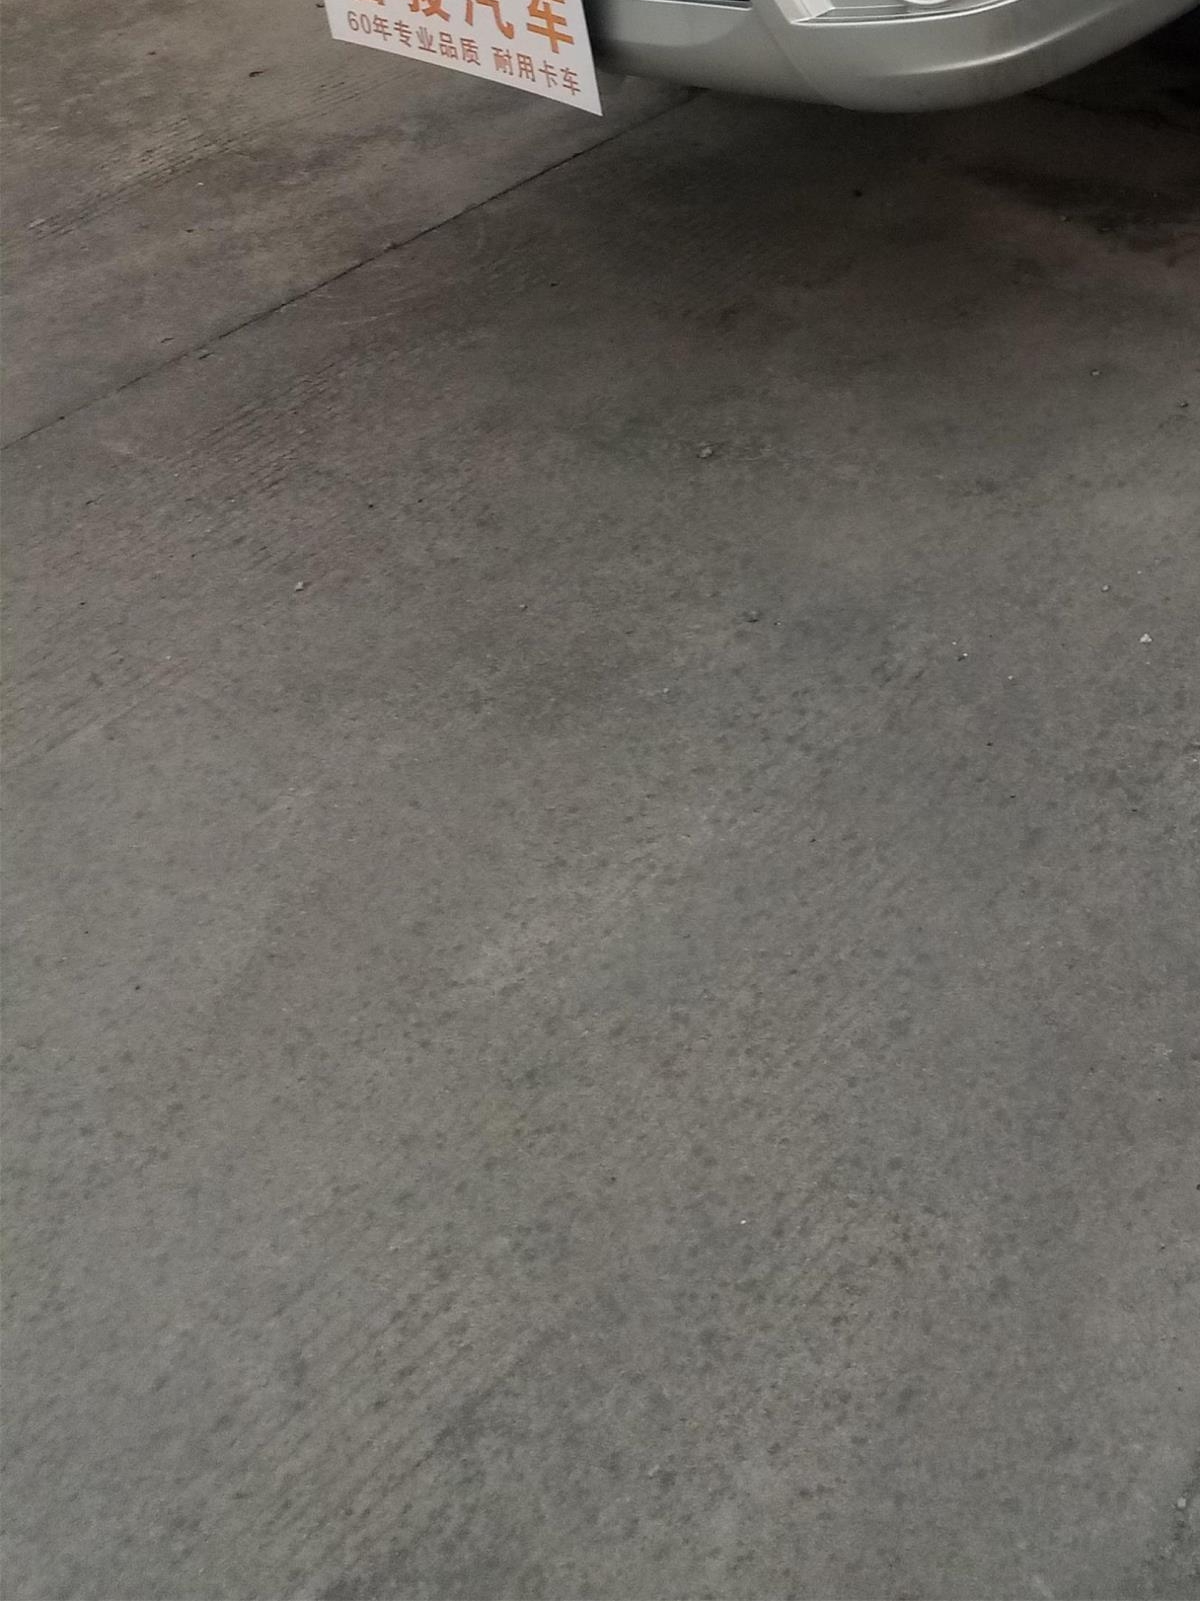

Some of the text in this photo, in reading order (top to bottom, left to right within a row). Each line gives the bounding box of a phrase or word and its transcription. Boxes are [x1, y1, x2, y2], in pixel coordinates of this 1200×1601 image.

[346, 9, 582, 96] 60年专业品质 耐用卡车
